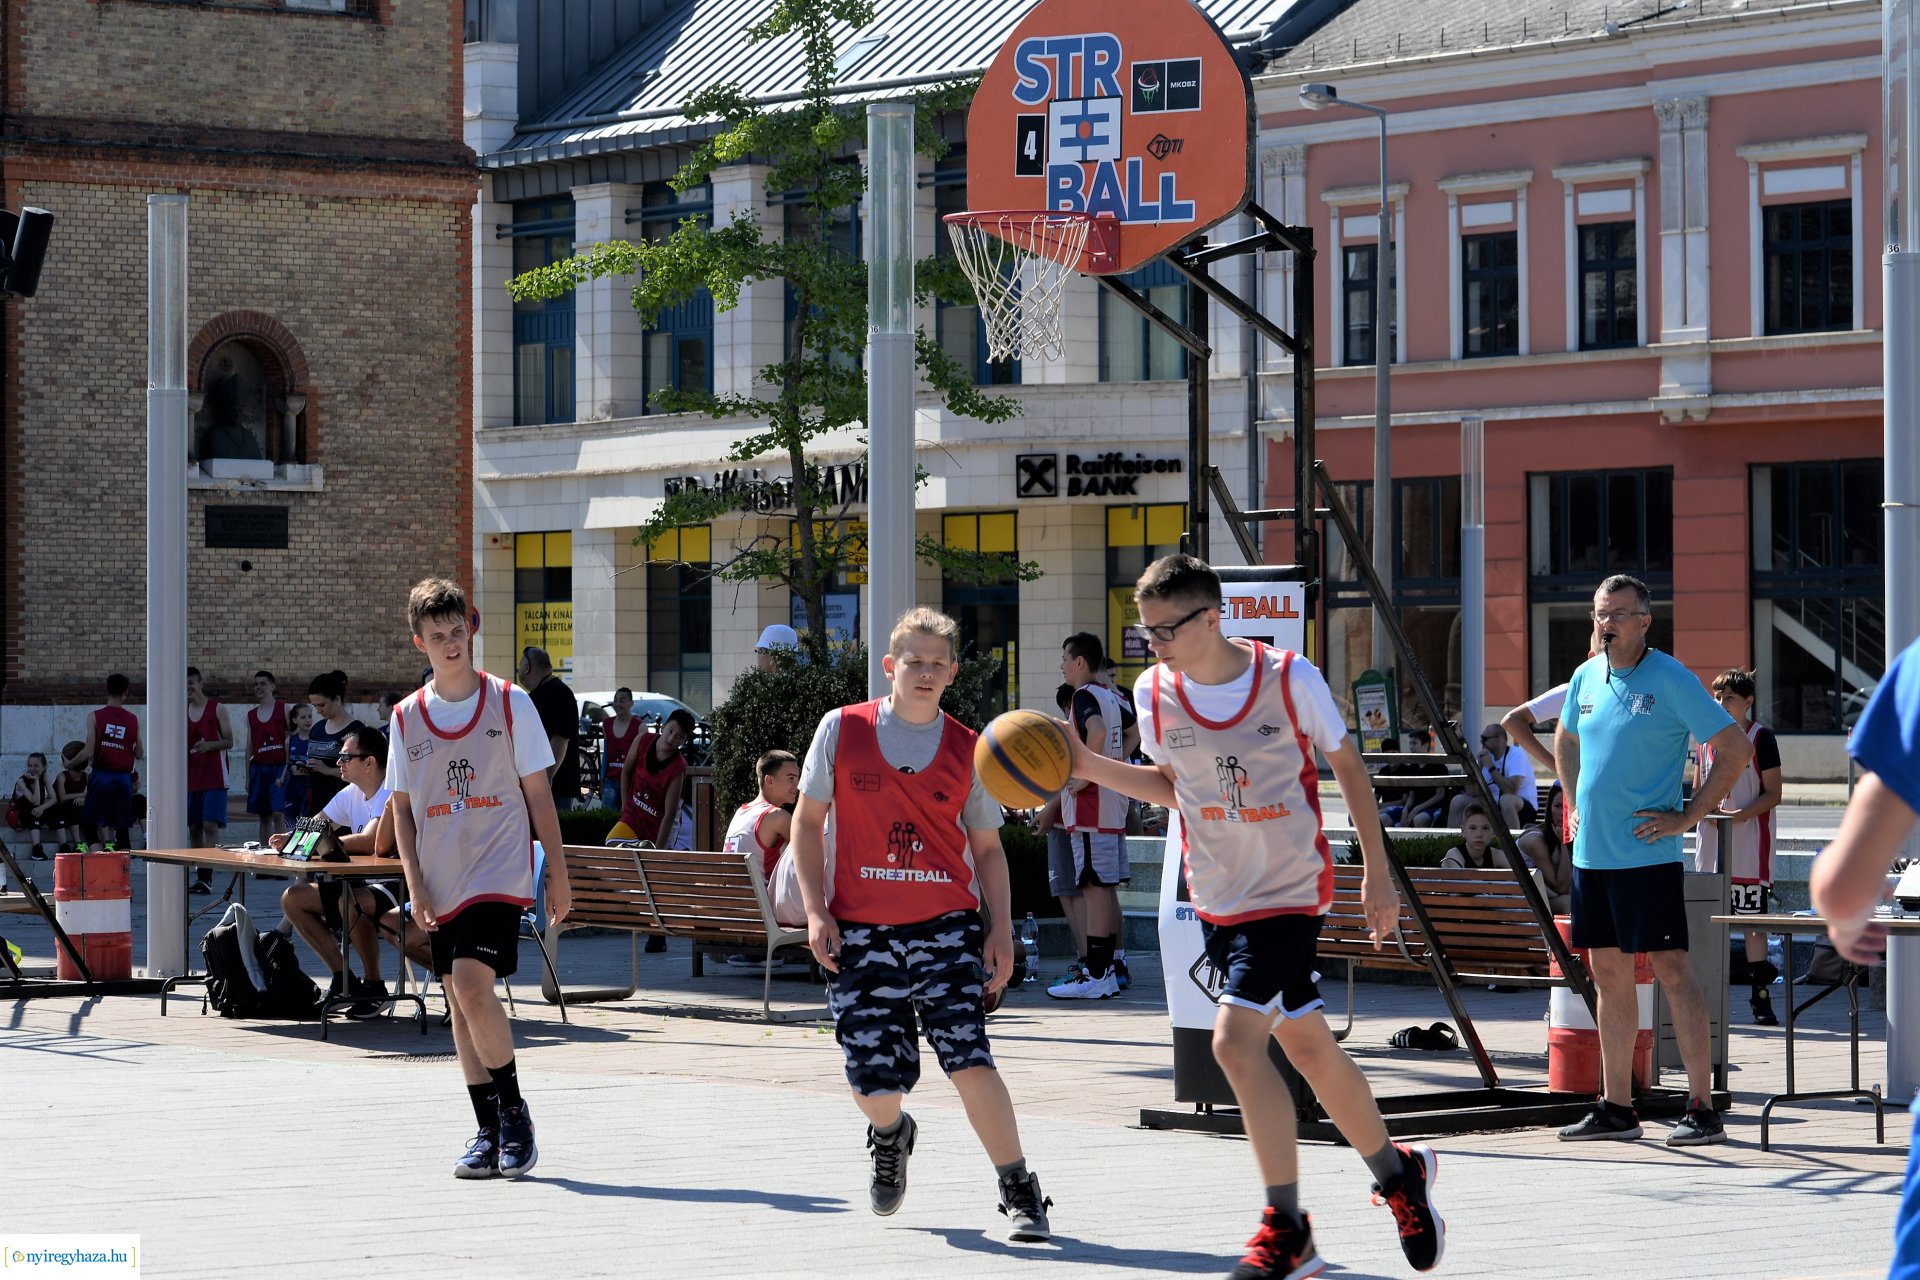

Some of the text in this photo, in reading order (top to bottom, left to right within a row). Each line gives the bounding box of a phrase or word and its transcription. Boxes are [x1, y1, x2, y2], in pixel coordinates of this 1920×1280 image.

[1012, 32, 1123, 105] STR
[1170, 80, 1197, 89] MKOSZ
[1024, 130, 1038, 161] 4
[1151, 136, 1184, 157] TOTI
[1047, 156, 1195, 227] BALL
[1888, 244, 1900, 253] 36
[1066, 452, 1182, 475] Raiffeisen
[1067, 476, 1139, 496] BANK
[524, 623, 530, 633] A
[426, 795, 503, 817] STREETBALL
[1200, 803, 1290, 823] STREETBALL
[860, 866, 953, 883] STREETBALL
